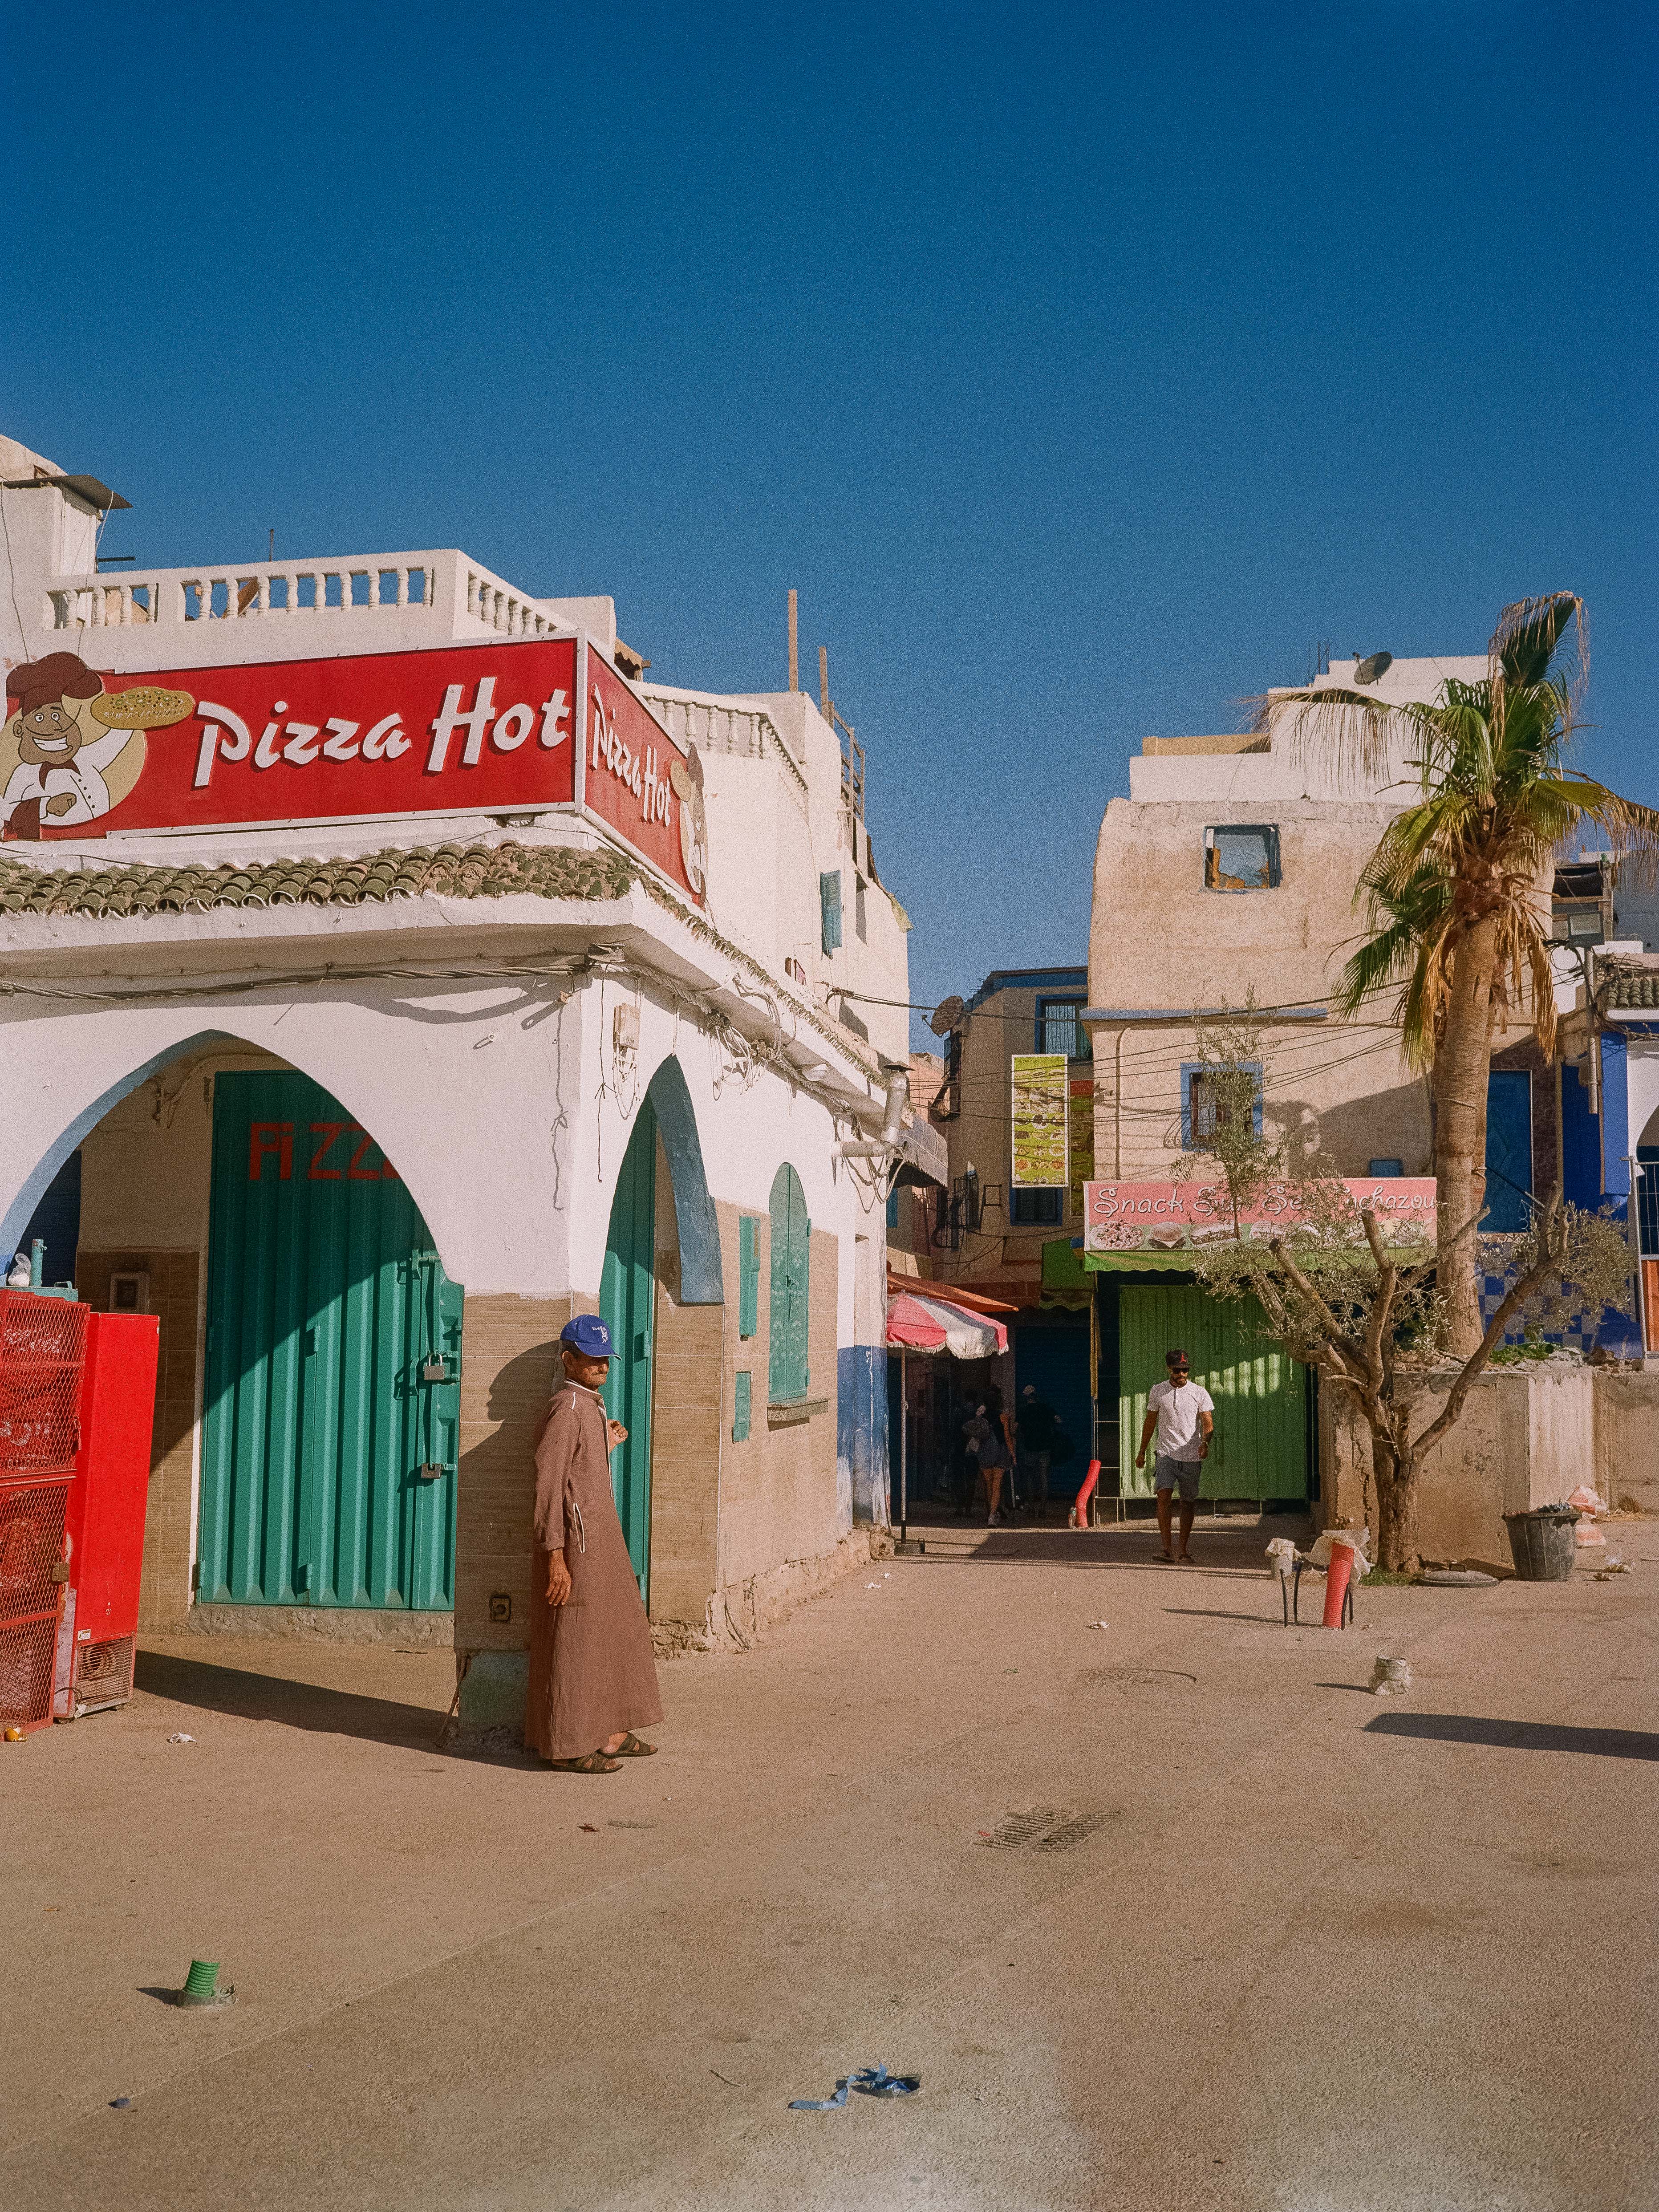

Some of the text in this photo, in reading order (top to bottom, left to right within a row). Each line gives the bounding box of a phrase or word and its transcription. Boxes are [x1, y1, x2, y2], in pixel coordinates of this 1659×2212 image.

[194, 676, 571, 787] Pizza Hot
[592, 683, 671, 827] Pizza Hot
[1094, 1187, 1184, 1218] Snack
